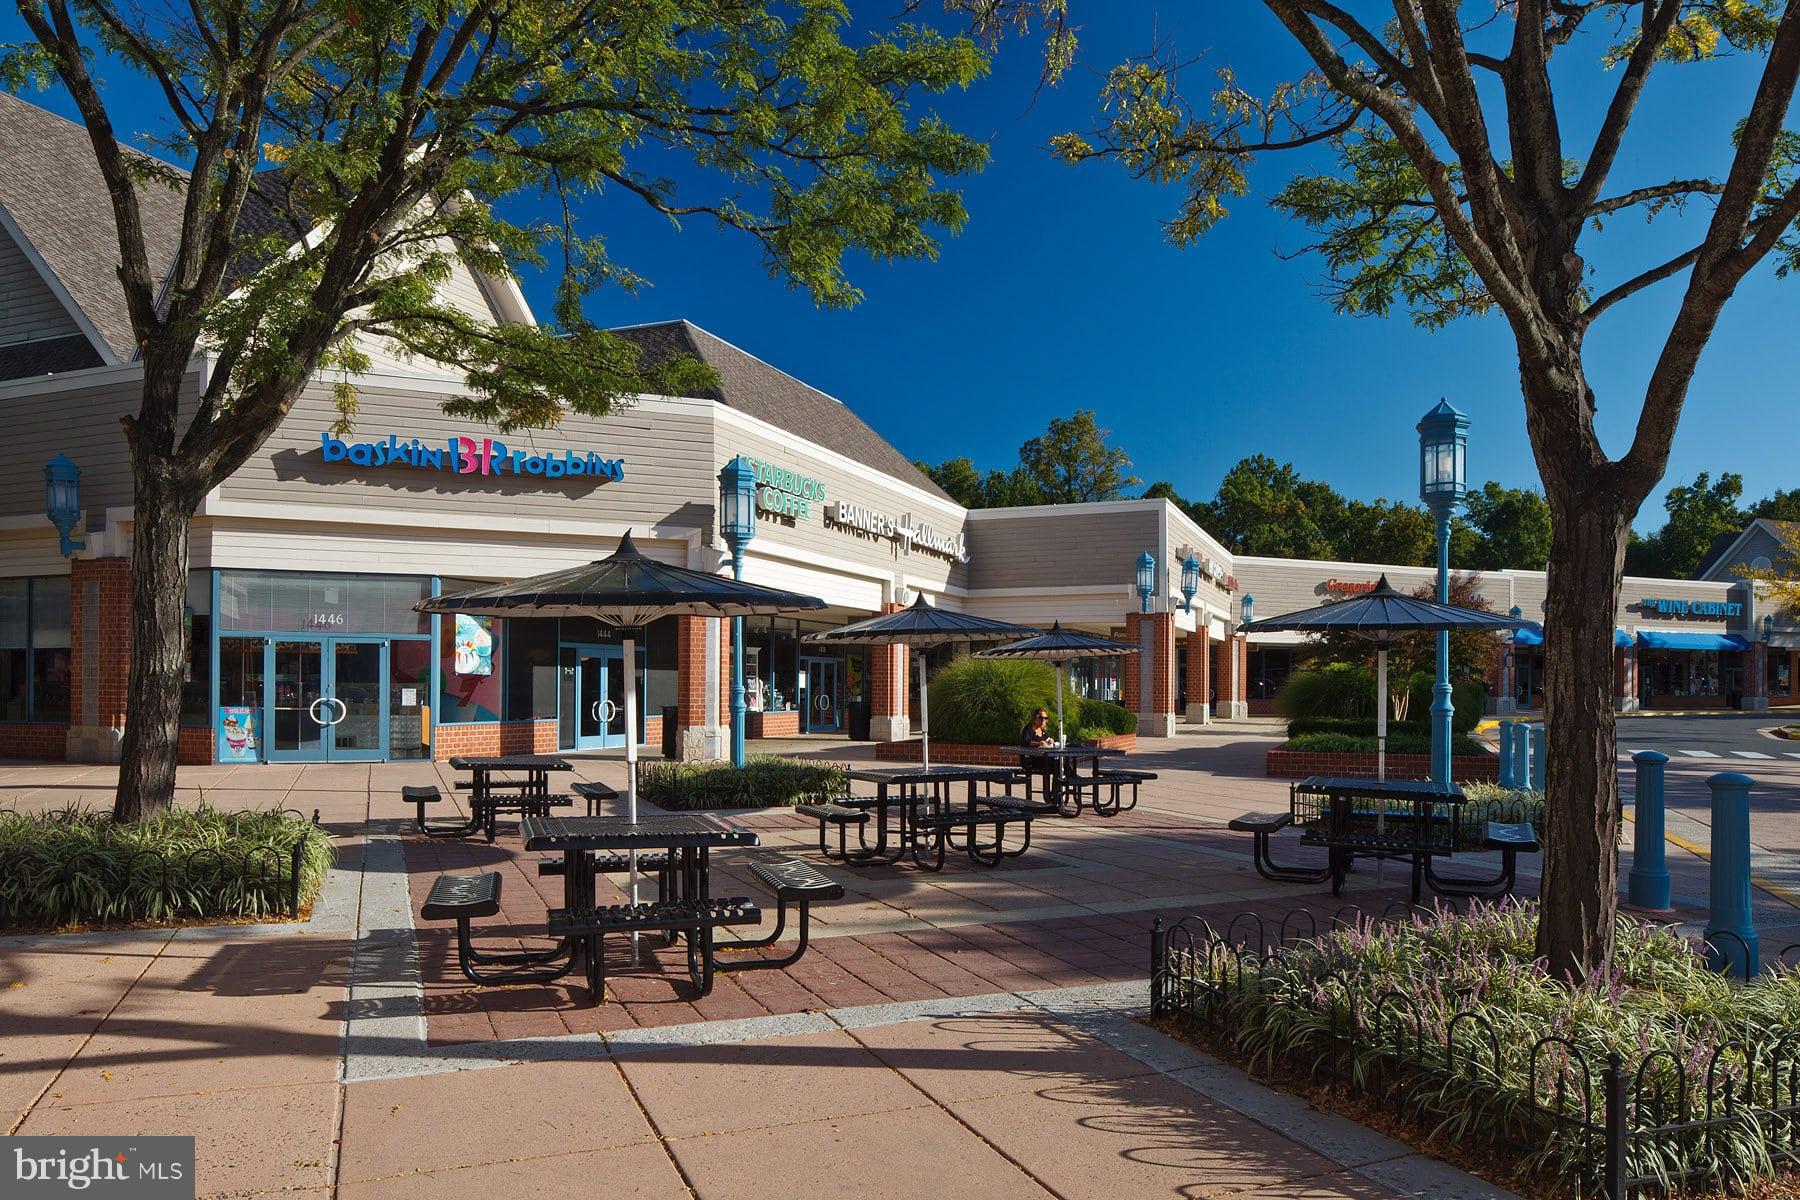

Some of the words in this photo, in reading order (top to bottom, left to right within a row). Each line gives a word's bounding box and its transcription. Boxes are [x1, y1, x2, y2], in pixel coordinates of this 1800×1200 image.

[321, 432, 443, 471] baskin
[512, 449, 625, 482] robbins
[745, 455, 826, 503] STARBUCKS
[763, 486, 813, 521] COFFEE
[838, 499, 895, 538] BANNER'S
[893, 511, 971, 564] Hallmark
[314, 613, 344, 625] 1446
[1658, 599, 1689, 615] WINE
[1691, 600, 1743, 617] CABINET
